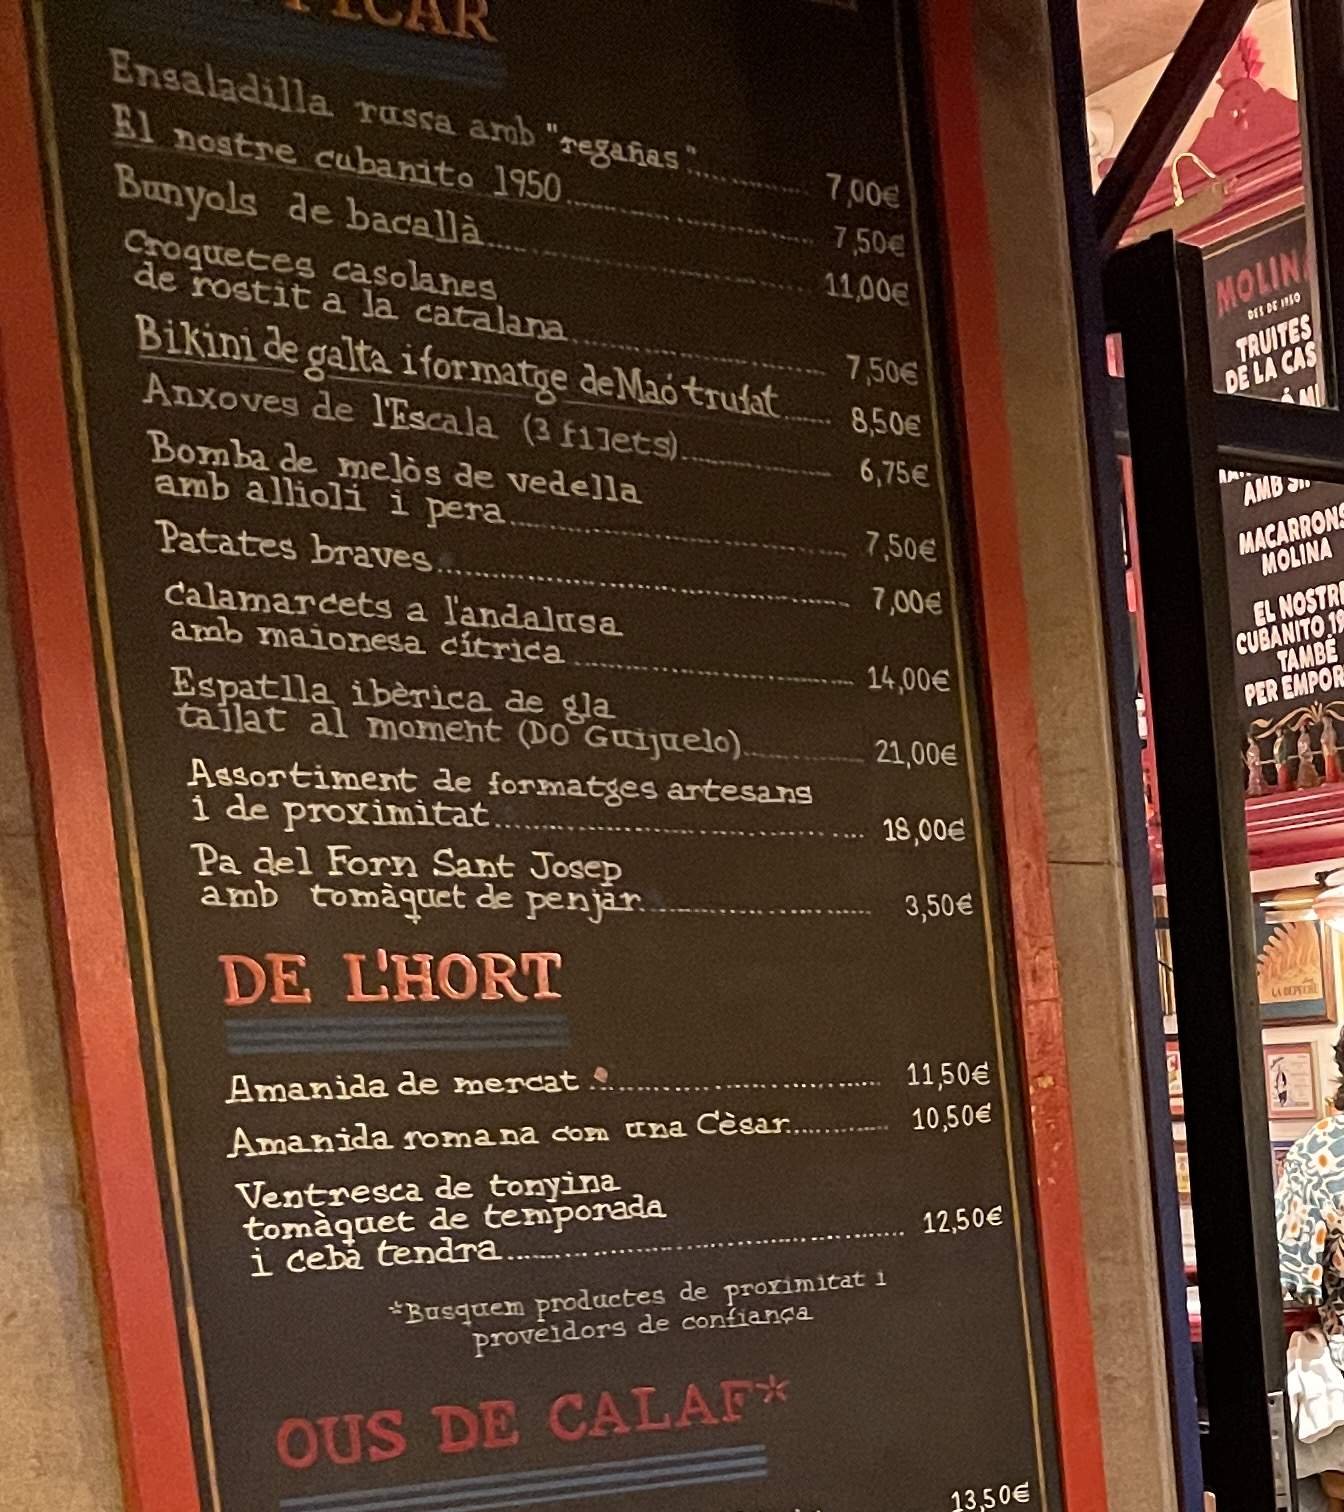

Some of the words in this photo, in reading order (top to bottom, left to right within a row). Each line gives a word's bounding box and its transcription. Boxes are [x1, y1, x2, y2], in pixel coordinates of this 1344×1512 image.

[110, 48, 333, 117] Ensaladilla
[827, 173, 899, 208] 7,00€
[174, 129, 296, 164] nostre
[315, 146, 473, 187] cubanito
[494, 166, 561, 202] 1950
[835, 226, 903, 256] 7,50€
[115, 163, 257, 221] Bunyols
[347, 197, 484, 245] bacallà
[826, 273, 908, 305] 11,00€
[192, 277, 310, 309] rostit
[416, 305, 567, 341] catalana
[847, 354, 917, 385] 7,50€
[1235, 313, 1313, 363] TRUITES
[135, 314, 256, 361] Bikini
[304, 336, 391, 382] galta
[420, 345, 567, 405] formatge
[614, 367, 677, 405] Maó
[852, 407, 920, 436] 8,50€
[1225, 364, 1250, 395] DE
[1253, 357, 1278, 386] LA
[1281, 340, 1318, 375] CAS
[143, 373, 298, 416] Anxoves
[861, 458, 928, 487] 6,75€
[147, 430, 269, 470] Bomba
[338, 452, 441, 485] melòs
[508, 470, 642, 504] vedella
[246, 476, 365, 511] allioli
[867, 531, 936, 562] 7,50€
[155, 520, 296, 560] Patates
[311, 533, 432, 572] braves
[873, 587, 941, 616] 7,00€
[1261, 536, 1333, 577] MOLINA
[445, 595, 623, 636] l'andalusa
[1236, 614, 1326, 656] CUBANITO
[1253, 599, 1276, 628] EL
[441, 631, 565, 664] cítrica
[869, 666, 949, 694] 14,00€
[1277, 633, 1339, 673] TAMBÉ
[171, 666, 333, 707] Espatlla
[352, 678, 492, 712] ibèrica
[1244, 678, 1279, 708] PER
[876, 740, 957, 768] 21,00€
[187, 758, 416, 792] Assortiment
[489, 772, 657, 807] formatges
[668, 779, 812, 804] artesans
[283, 798, 489, 832] proximitat
[884, 817, 964, 846] 18,00€
[328, 845, 417, 877] Forn
[433, 848, 514, 878] Sant
[530, 851, 621, 887] Josep
[311, 883, 465, 924] tomàquet
[906, 894, 972, 923] 3,50€
[219, 953, 311, 1005] DE
[344, 949, 561, 1001] L'HORT
[226, 1074, 388, 1104] Amanida
[454, 1071, 579, 1094] mercat
[909, 1062, 989, 1090] 11,50€
[227, 1123, 393, 1158] Amanida
[405, 1127, 539, 1150] romana
[913, 1103, 991, 1132] 10,50€
[235, 1181, 423, 1208] Ventresca
[490, 1171, 620, 1203] tonyina
[243, 1211, 414, 1246] tomàquet
[484, 1194, 666, 1233] temporada
[378, 1237, 502, 1266] tendra
[925, 1206, 1001, 1233] 12,50€
[536, 1289, 664, 1322] productes
[724, 1273, 863, 1306] proximitat
[683, 1307, 813, 1329] confiança
[277, 1410, 406, 1468] OUS
[432, 1400, 519, 1452] DE
[952, 1482, 1028, 1512] 13,50€
